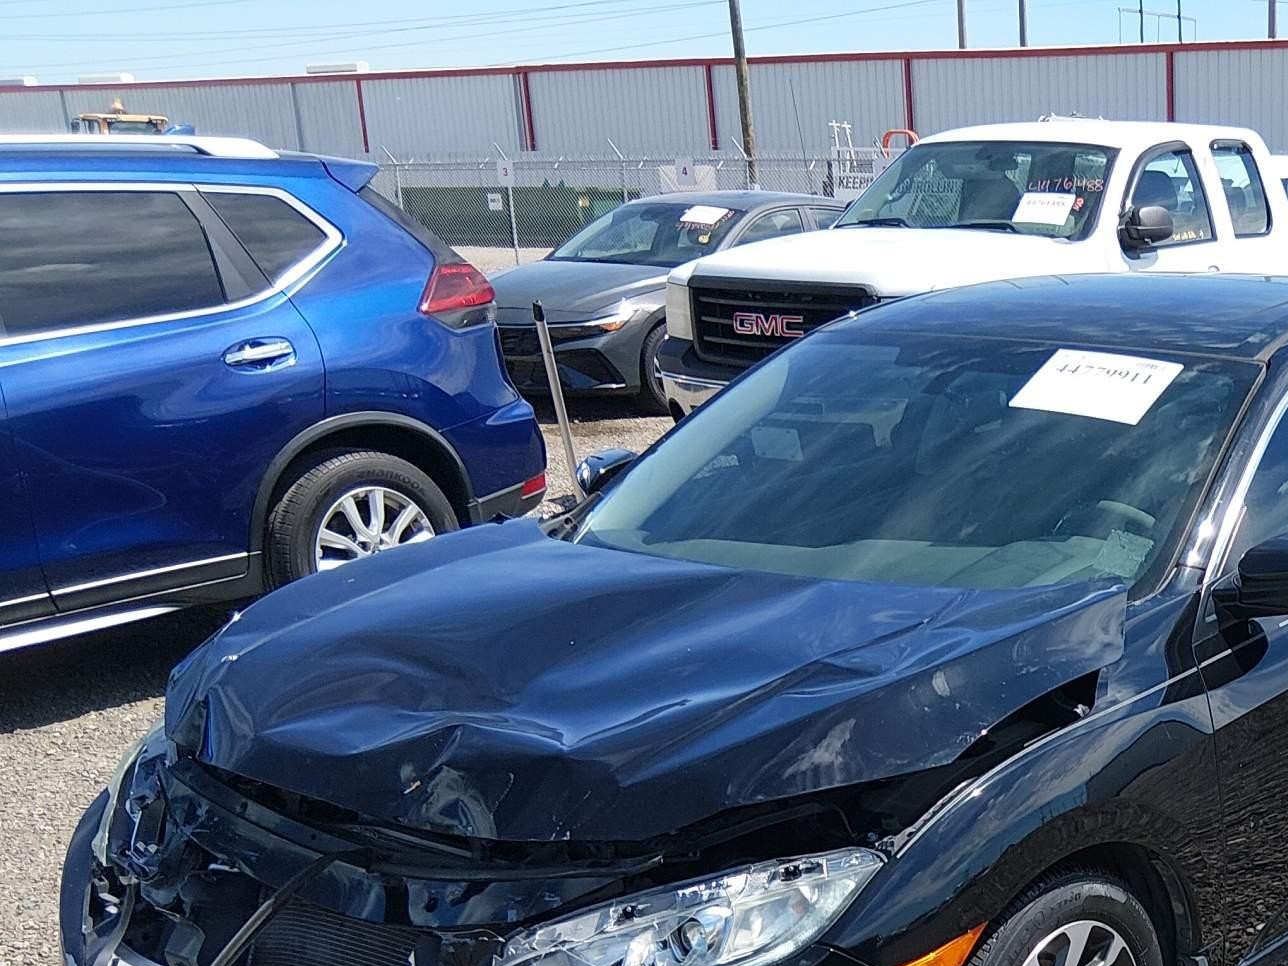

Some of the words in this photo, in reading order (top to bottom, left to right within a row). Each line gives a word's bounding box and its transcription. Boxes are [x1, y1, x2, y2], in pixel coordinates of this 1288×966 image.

[502, 168, 509, 177] 3
[681, 167, 688, 177] 4
[733, 312, 804, 337] GMC
